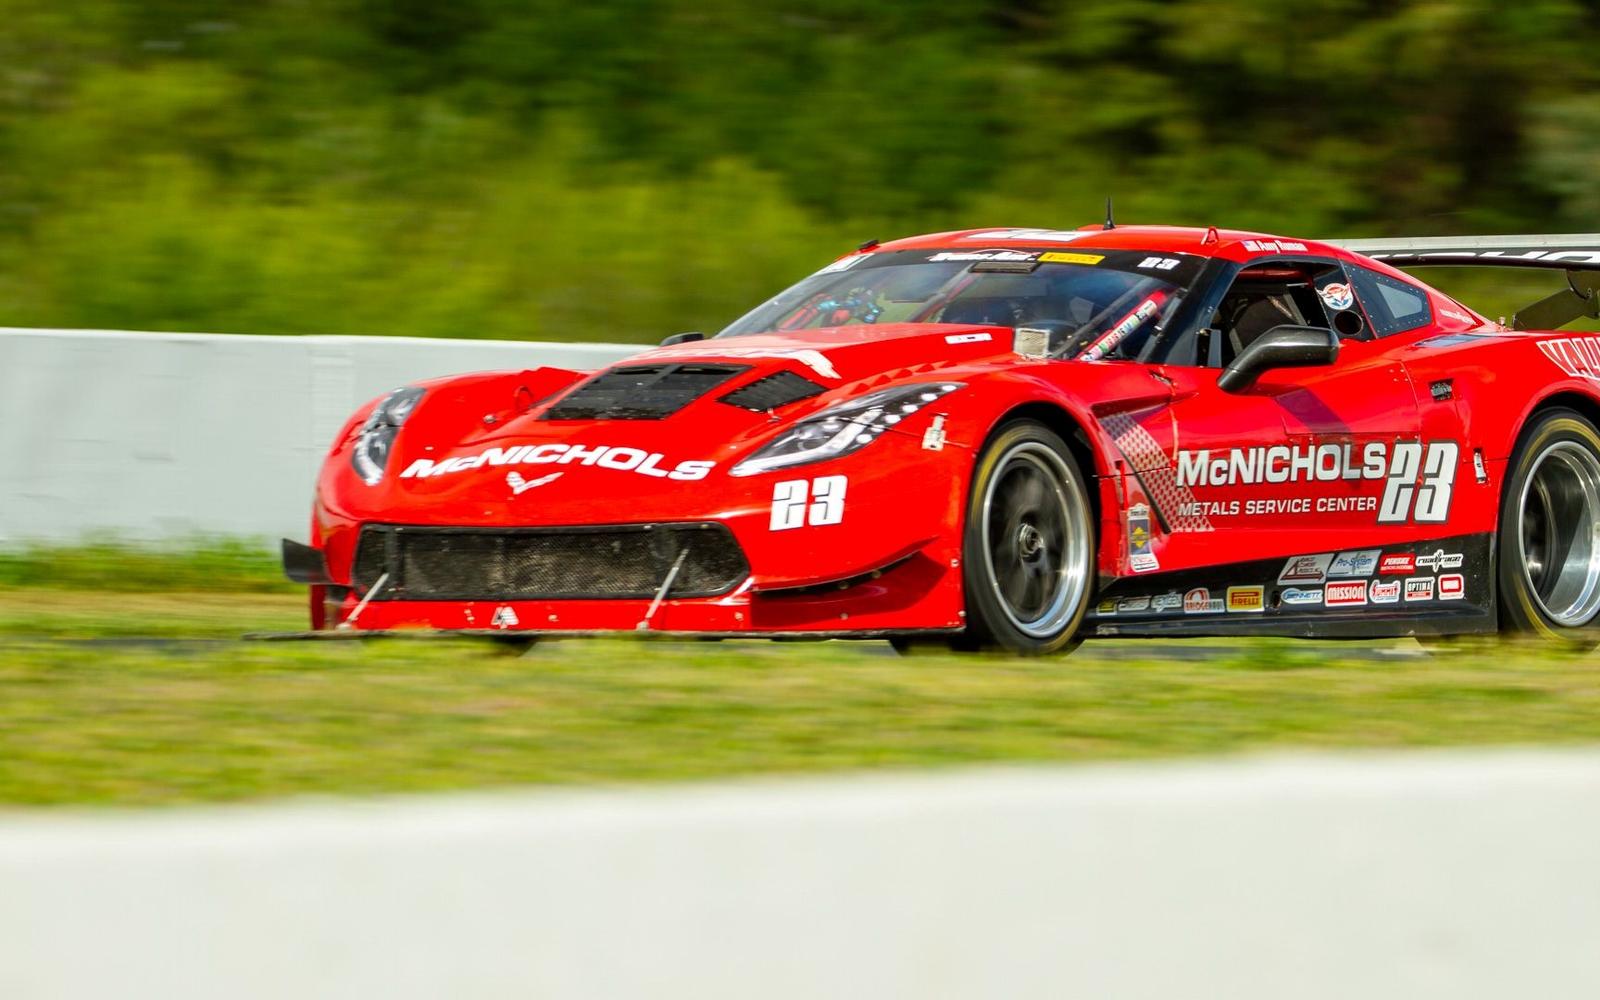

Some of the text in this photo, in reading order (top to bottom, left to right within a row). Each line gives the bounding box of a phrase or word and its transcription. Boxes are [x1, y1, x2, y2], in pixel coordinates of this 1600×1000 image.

[399, 443, 717, 481] McNICHOLS
[1176, 442, 1387, 487] McNICHOLS
[1377, 441, 1459, 523] 23
[768, 475, 848, 532] 23
[1178, 497, 1377, 518] METALS SERVICE CENTER
